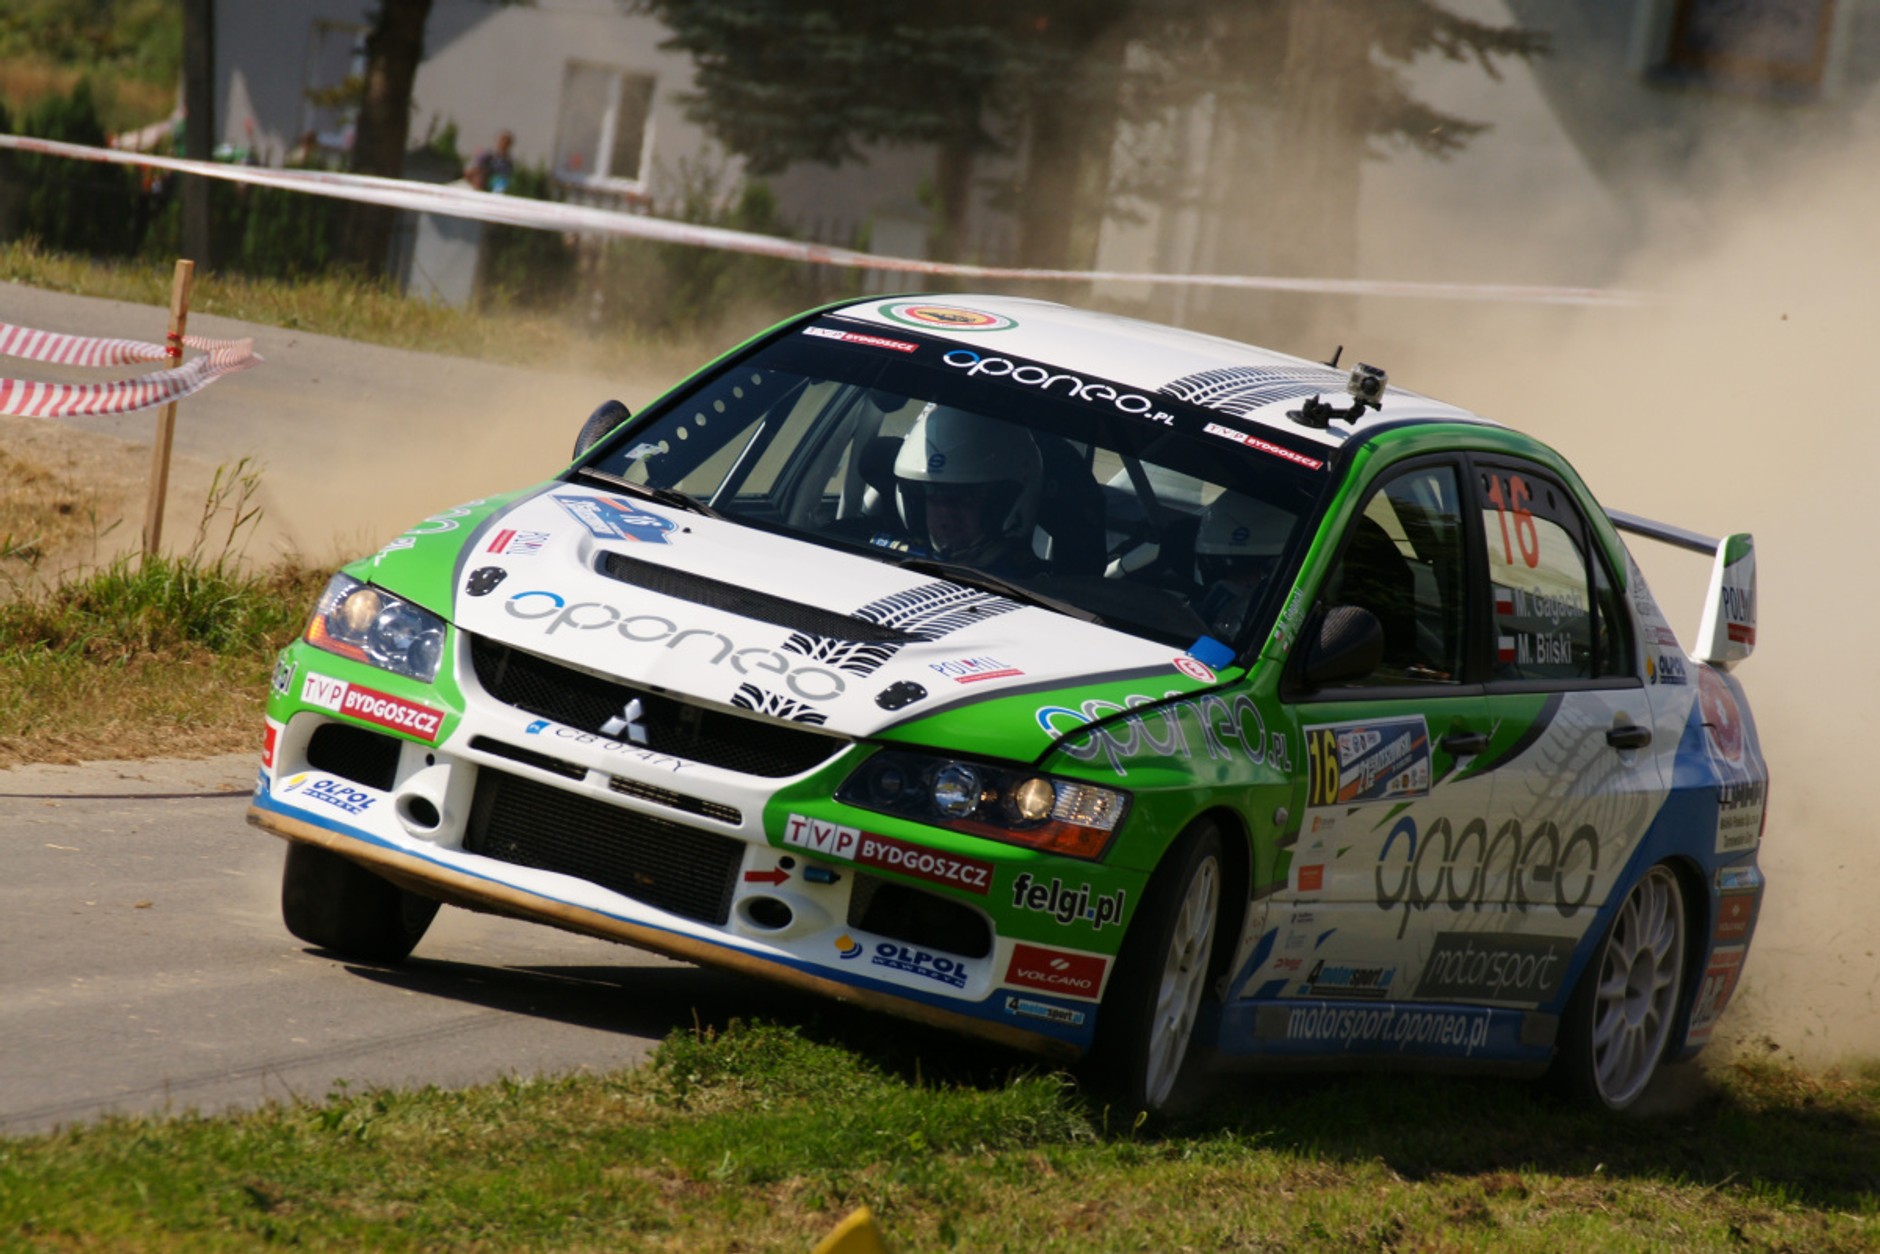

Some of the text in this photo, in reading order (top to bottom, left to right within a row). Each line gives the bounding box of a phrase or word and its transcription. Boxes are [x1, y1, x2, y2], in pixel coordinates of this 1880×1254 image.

[1209, 424, 1319, 468] TVP BYDGOSZCZ
[1488, 474, 1540, 569] 16
[505, 591, 846, 701] oponeo
[1517, 632, 1573, 665] M. Bilski
[306, 678, 438, 734] TVP BYDGOSZCZ
[555, 727, 599, 745] CB
[313, 779, 377, 810] OLPOL
[1310, 728, 1340, 806] 16
[790, 820, 989, 888] TVP BYDGOSZCZ
[1376, 816, 1599, 941] oponeo
[1012, 873, 1126, 931] felgi.pl
[876, 943, 968, 980] OLPOL
[1017, 968, 1092, 989] VOLCANO
[1425, 940, 1559, 999] motorsport
[1287, 1002, 1492, 1057] motorsport.oponeo.pl
